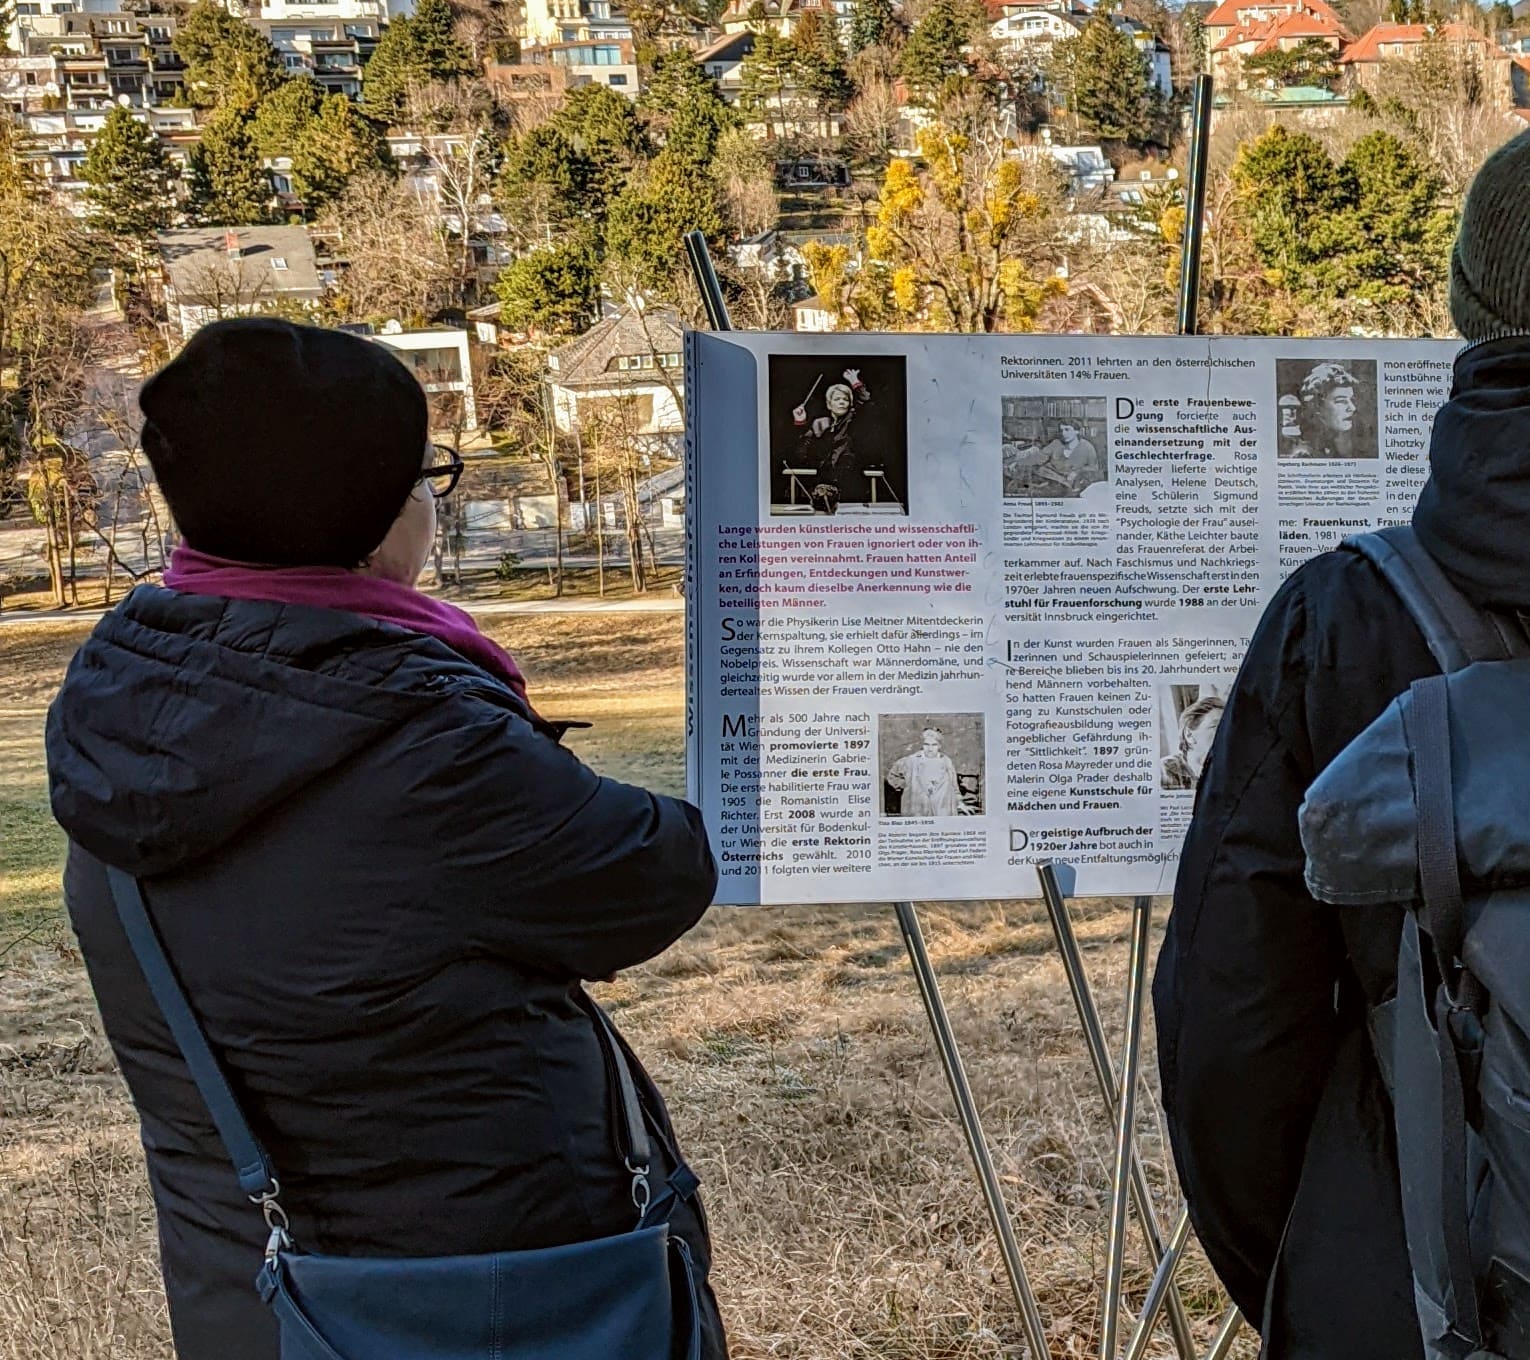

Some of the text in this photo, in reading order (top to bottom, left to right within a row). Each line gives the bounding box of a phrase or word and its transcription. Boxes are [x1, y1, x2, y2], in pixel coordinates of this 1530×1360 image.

[1000, 356, 1064, 366] Rektorinnen.
[1068, 356, 1092, 366] 2011
[1096, 356, 1133, 366] lehrten
[1152, 357, 1172, 366] den
[1175, 357, 1256, 367] österreichischen
[1406, 359, 1452, 368] eröffnete
[1001, 369, 1130, 379] Universitäten 14% Frauen.
[1384, 372, 1442, 382] kunstbühne
[1384, 385, 1444, 395] lerinnen wie
[1114, 423, 1257, 433] die wissenschaftliche Aus-
[1114, 436, 1258, 448] einandersetzung mit der
[1385, 438, 1425, 450] Lihotzky
[1114, 450, 1258, 462] Geschlechterfrage. Rosa
[1115, 463, 1258, 475] Mayreder lieferte wichtige
[1114, 477, 1258, 489] Analysen, Helene Deutsch,
[1115, 504, 1259, 516] Freuds, setzte sich mit der
[1302, 516, 1372, 529] Frauenkunst,
[718, 523, 978, 536] Lange wurden künstlerische und wissenschaftli-
[1314, 529, 1337, 539] 1981
[718, 539, 738, 549] che
[740, 539, 801, 551] Leistungen
[826, 538, 864, 548] Frauen
[867, 538, 916, 550] ignoriert
[918, 538, 943, 548] oder
[945, 540, 966, 548] von
[968, 538, 982, 547] ih-
[739, 553, 788, 566] Kollegen
[790, 553, 864, 563] vereinnahmt.
[866, 553, 904, 562] Frauen
[906, 553, 942, 562] hatten
[944, 552, 976, 562] Anteil
[1004, 557, 1258, 569] terkammer auf. Nach Faschismus und Nachkriegs-
[735, 568, 806, 580] Erfindungen,
[809, 567, 888, 580] Entdeckungen
[890, 567, 912, 577] und
[914, 567, 969, 577] Kunstwer-
[719, 582, 972, 595] ken, doch kaum dieselbe Anerkennung wie die
[1006, 583, 1260, 596] 1970er Jahren neuen Aufschwung. Der erste Lehr-
[719, 597, 826, 610] beteiligten Männer.
[1004, 598, 1032, 607] stuhl
[1033, 598, 1050, 607] für
[1052, 597, 1142, 610] Frauenforschung
[1144, 597, 1176, 607] wurde
[1178, 597, 1204, 607] 1988
[1220, 597, 1237, 606] der
[1239, 597, 1259, 606] Uni-
[1004, 611, 1158, 623] versität Innsbruck eingerichtet.
[720, 658, 779, 670] Nobelpreis.
[782, 657, 849, 667] Wissenschaft
[852, 659, 872, 667] war
[963, 656, 984, 666] und
[720, 669, 984, 684] gleichzeitig wurde vor allem in der Medizin jahrhun-
[720, 684, 923, 696] dertealtes Wissen der Frauen verdrängt.
[1006, 731, 1152, 744] angeblicher Gefährdung ih-
[720, 739, 870, 753] tät Wien promovierte 1897
[720, 752, 871, 765] mit der Medizinerin Gabrie-
[1006, 758, 1152, 771] deten Rosa Mayreder und die
[720, 767, 871, 778] le Possanner die erste Frau.
[1007, 785, 1153, 799] eine eigene Kunstschule für
[722, 794, 871, 806] 1905 die Romanistin Elise
[721, 835, 871, 847] tur Wien die erste Rektorin
